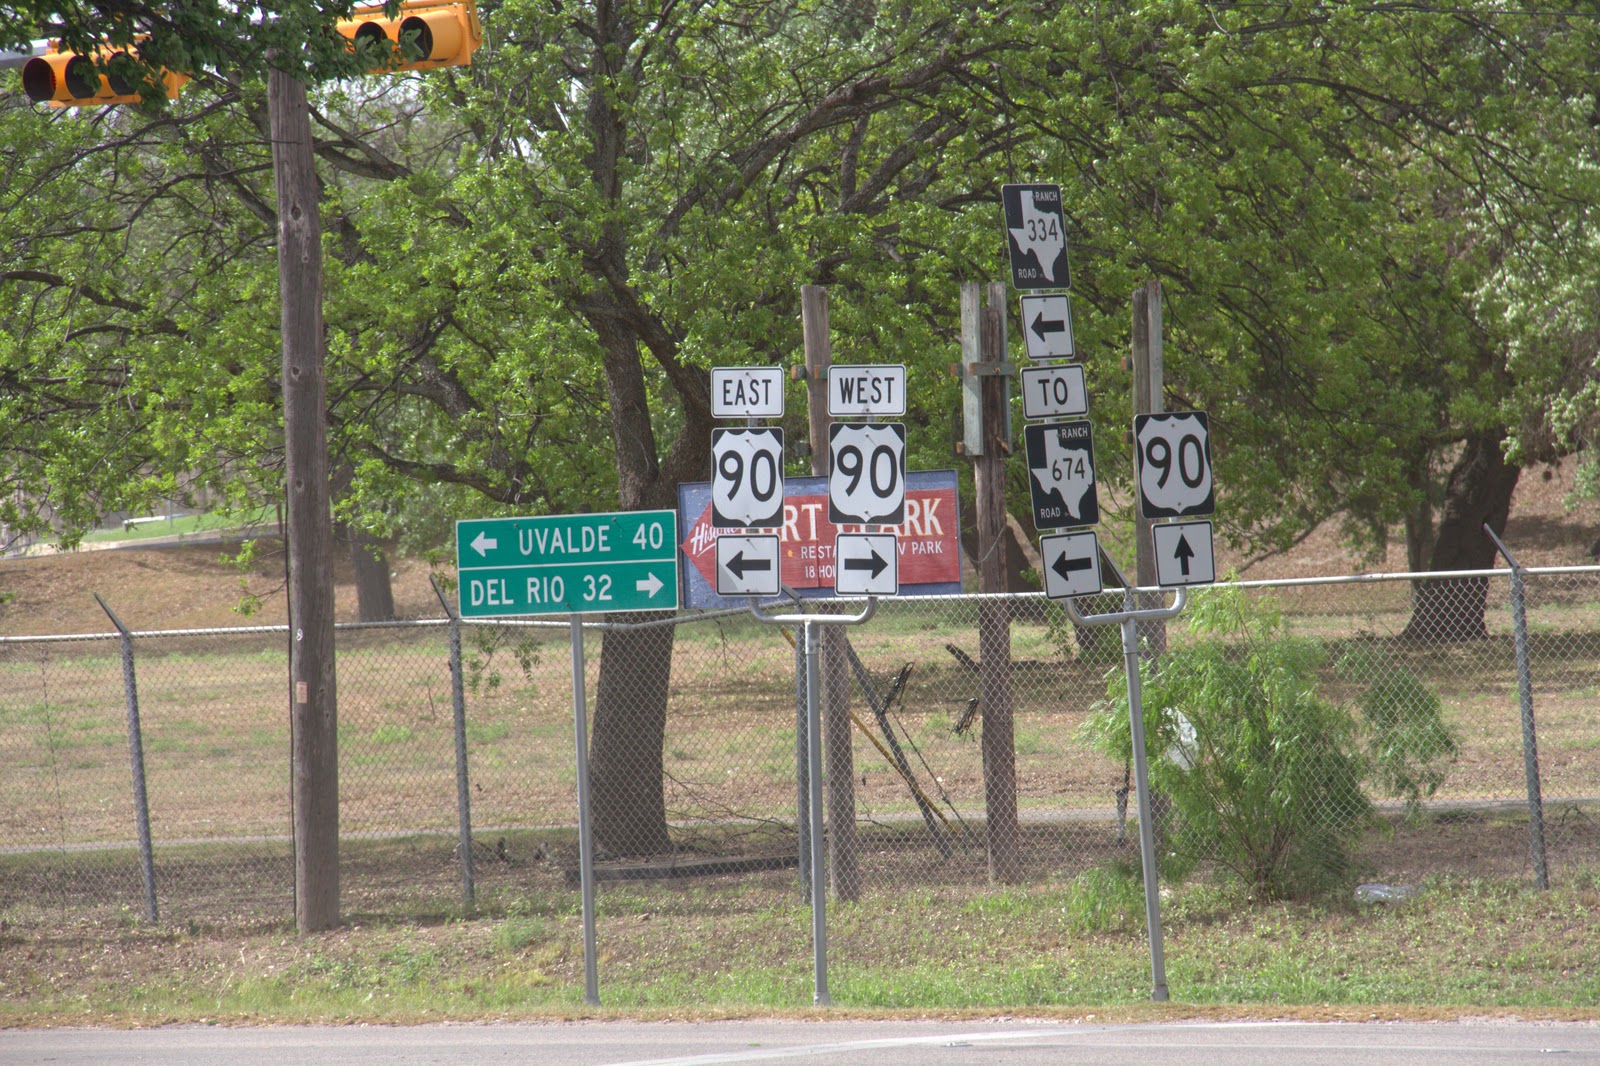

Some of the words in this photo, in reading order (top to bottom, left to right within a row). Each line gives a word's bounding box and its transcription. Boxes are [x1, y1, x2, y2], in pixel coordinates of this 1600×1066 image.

[1034, 191, 1058, 202] RANCH
[1027, 218, 1058, 242] 334
[1018, 268, 1037, 279] ROAD
[722, 379, 772, 406] EAST
[839, 377, 895, 404] WEST
[1038, 377, 1068, 406] TO
[1061, 426, 1088, 439] RANCH
[837, 444, 898, 499] 90
[1052, 457, 1085, 481] 674
[1145, 433, 1205, 490] 90
[719, 448, 777, 502] 90
[1040, 507, 1061, 519] ROAD
[518, 525, 611, 556] UVALDE
[632, 522, 664, 550] 40
[912, 540, 943, 554] PARK
[804, 565, 815, 578] 18
[471, 578, 514, 606] DEL
[527, 575, 565, 604] RIO
[582, 574, 612, 601] 32
